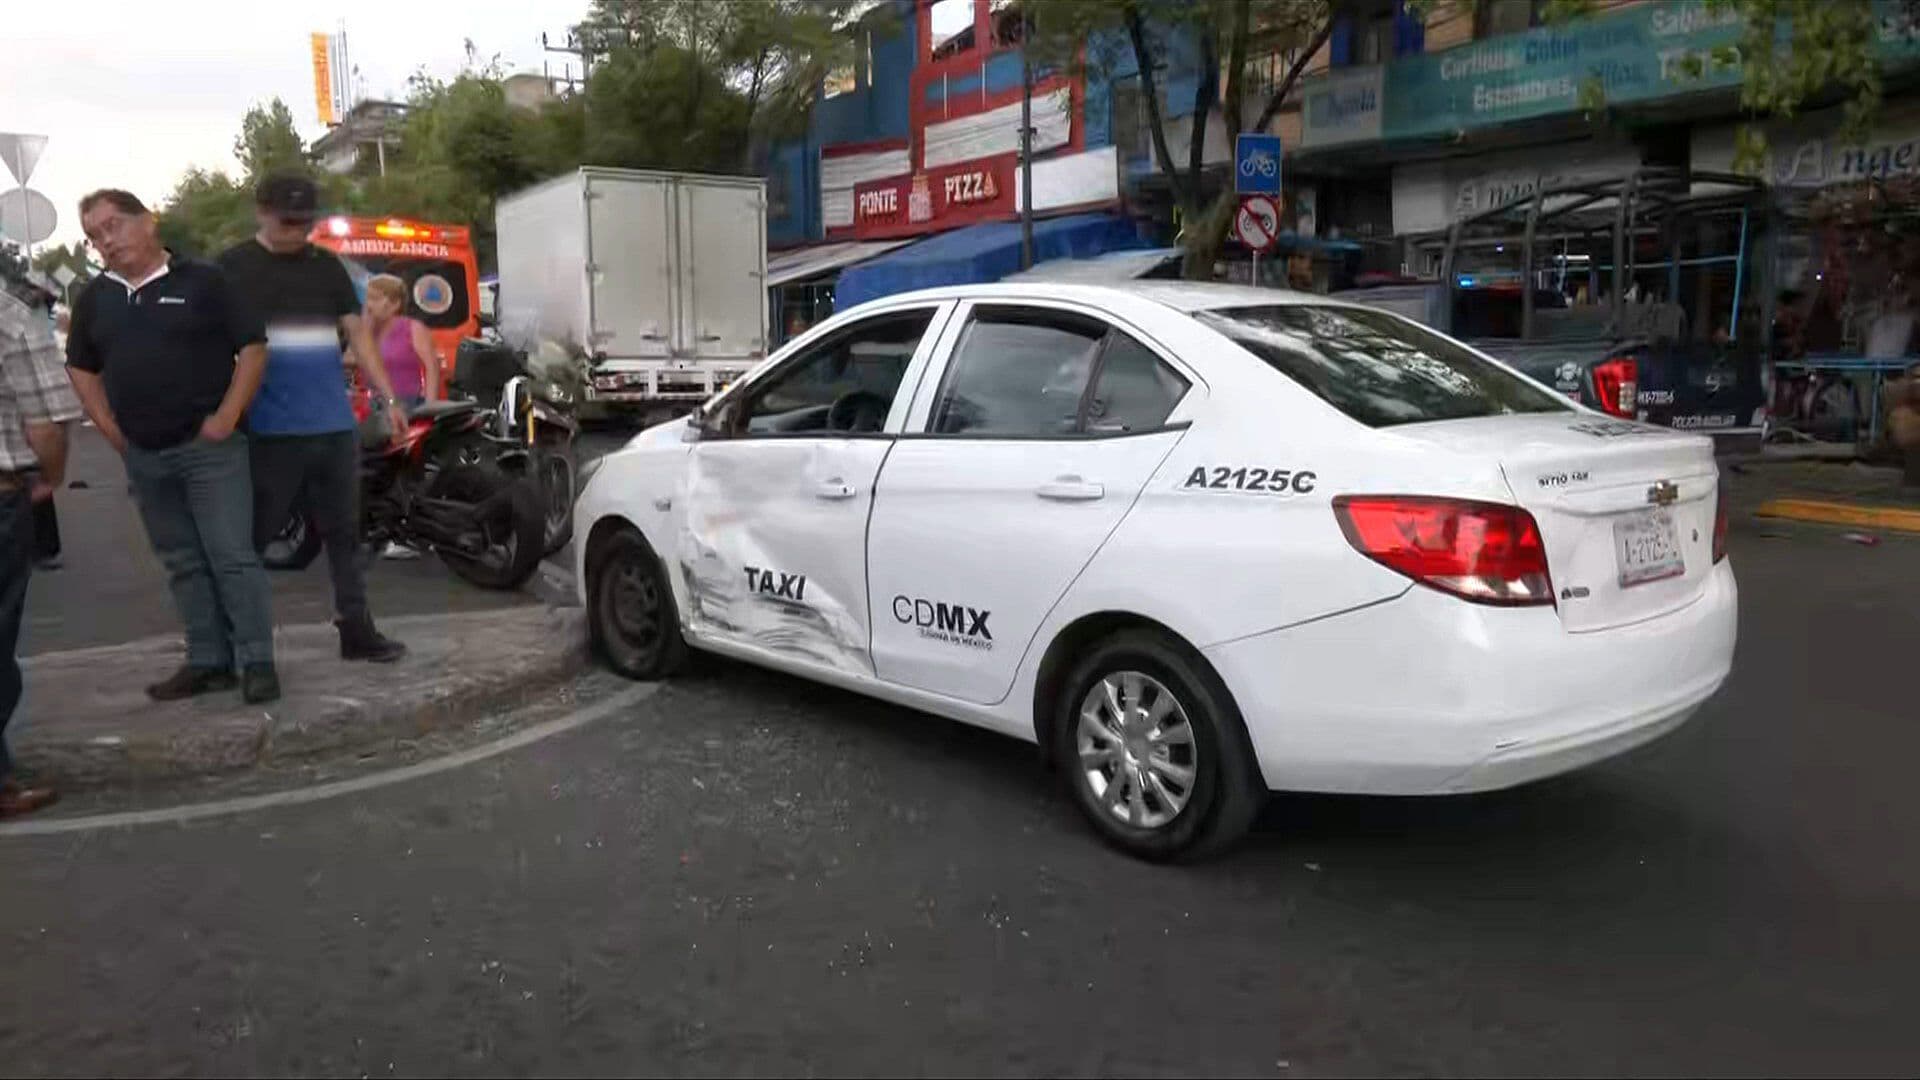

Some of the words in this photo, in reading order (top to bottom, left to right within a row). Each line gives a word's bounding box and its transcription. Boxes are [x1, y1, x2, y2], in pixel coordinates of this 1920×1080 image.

[859, 188, 898, 215] PONTE
[340, 239, 449, 257] AMBULANCIA
[1183, 467, 1318, 494] A2125C
[743, 566, 807, 600] TAXI
[893, 595, 992, 640] CDMX
